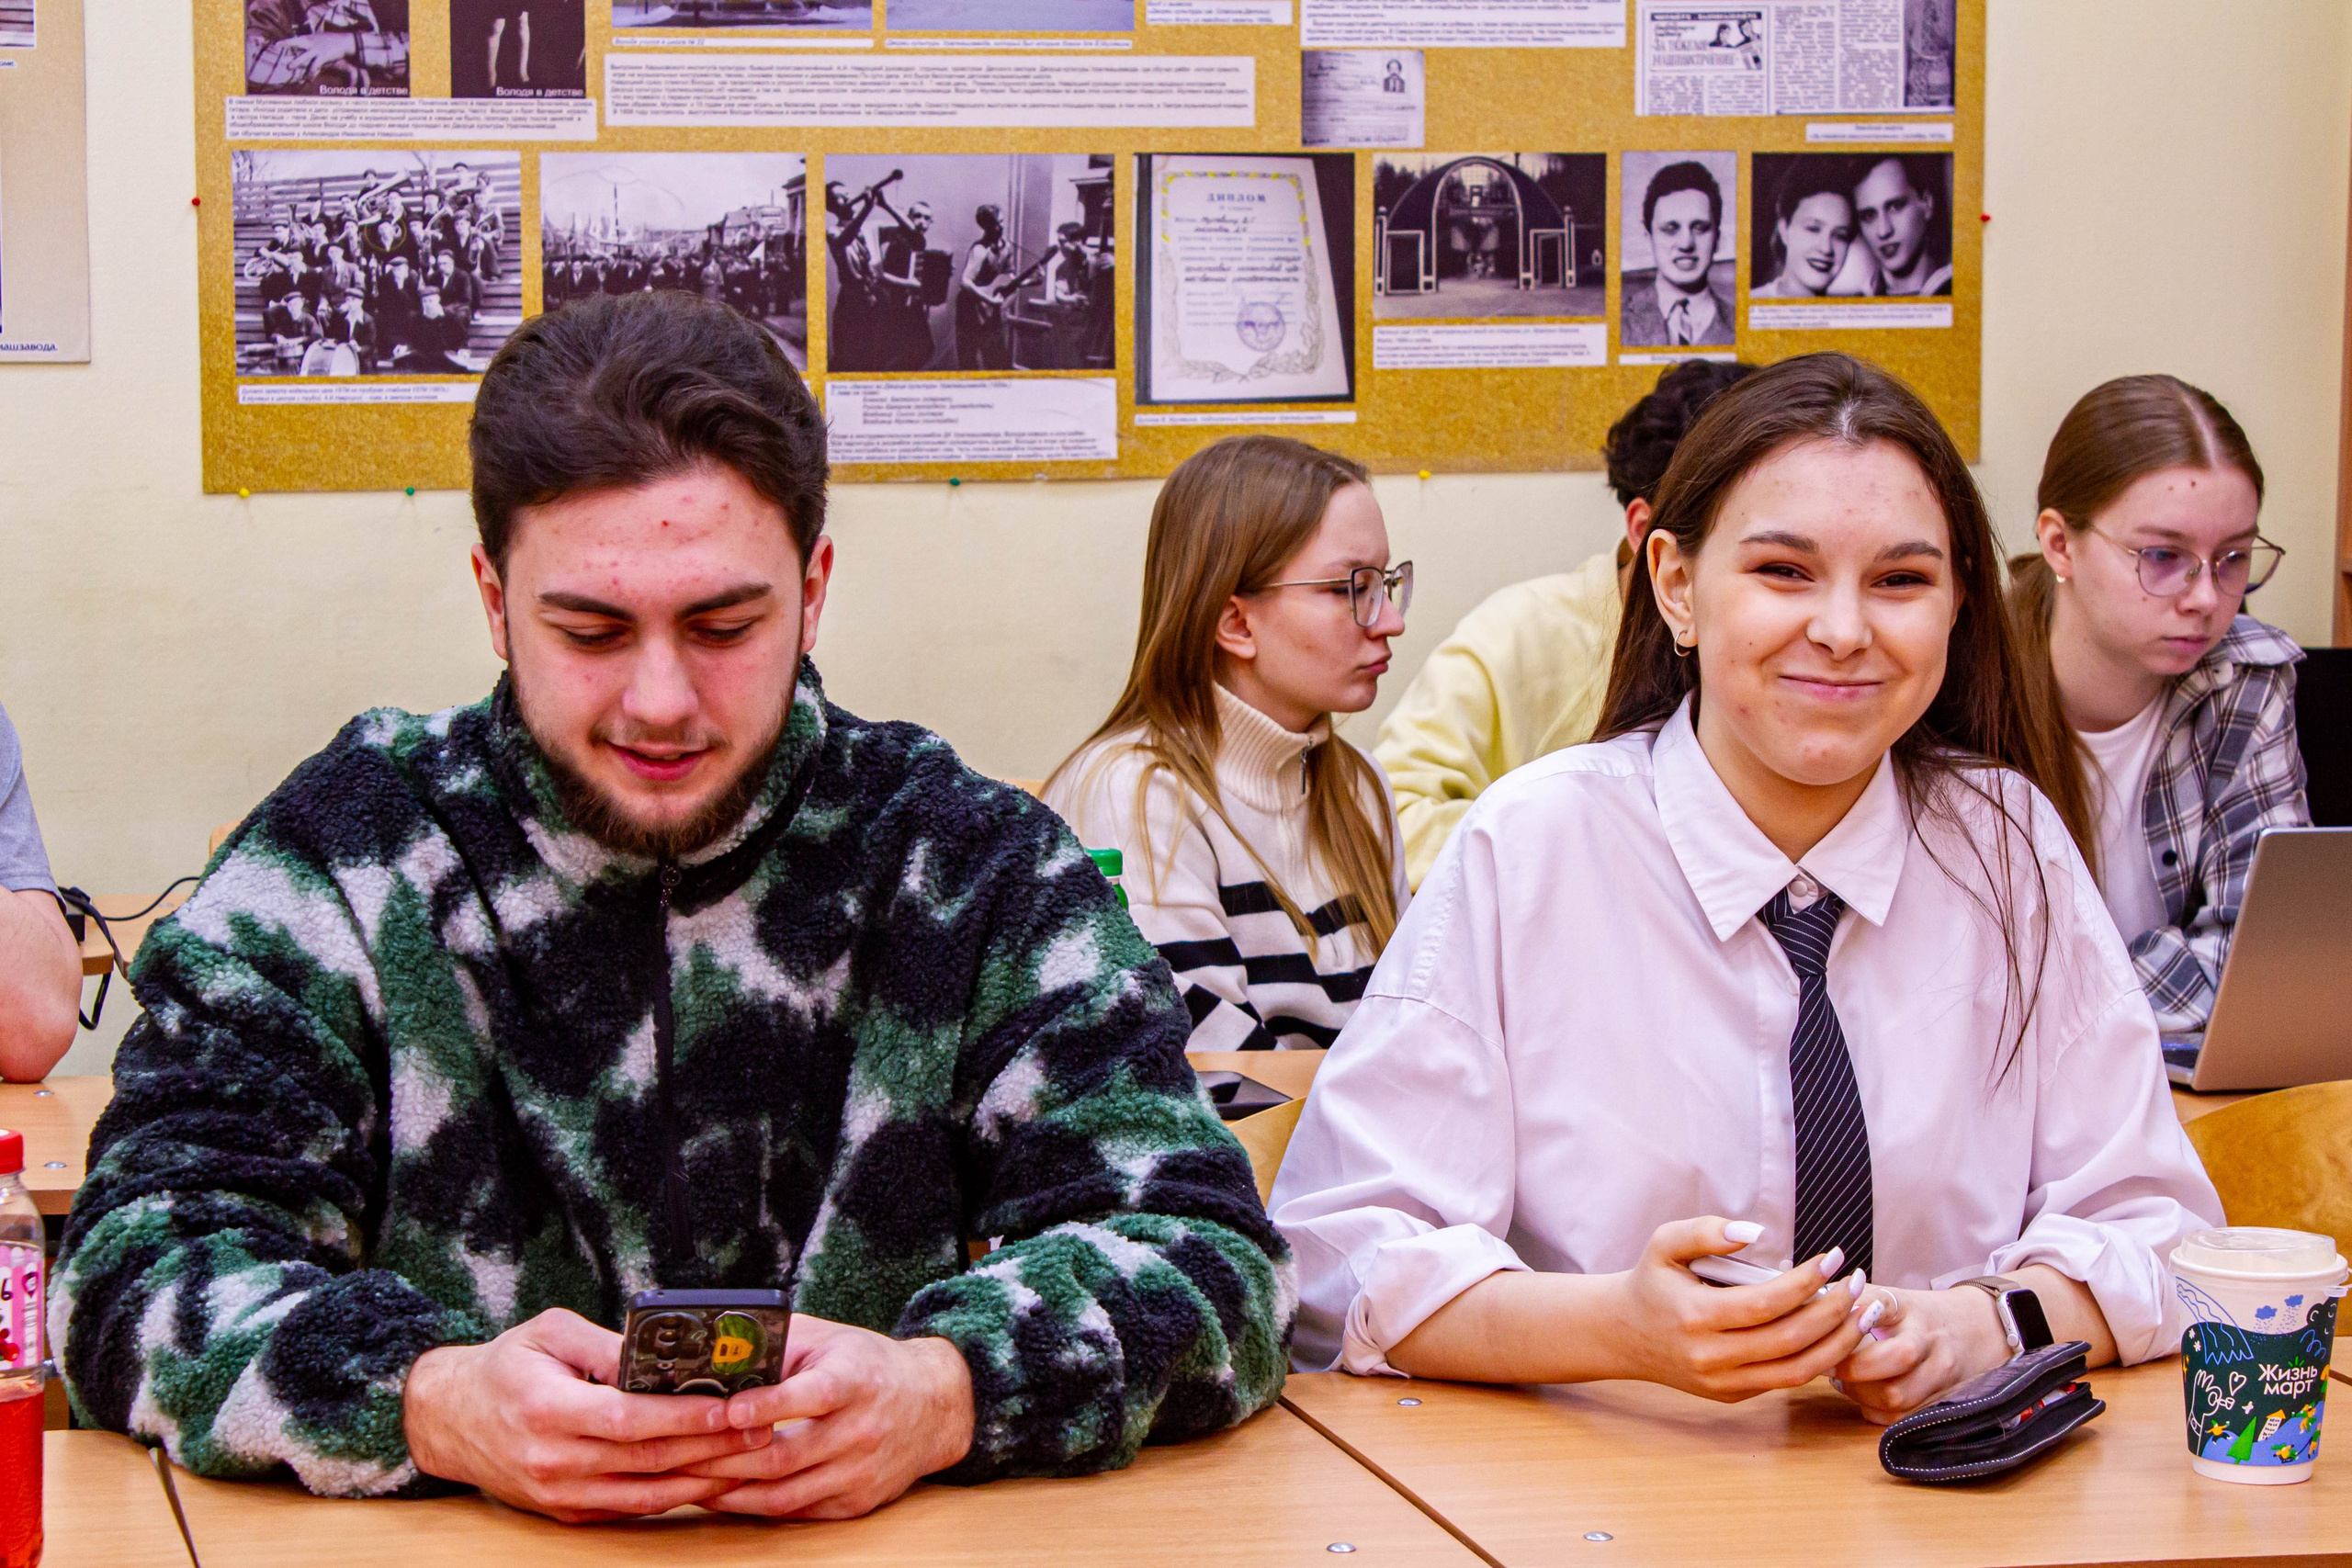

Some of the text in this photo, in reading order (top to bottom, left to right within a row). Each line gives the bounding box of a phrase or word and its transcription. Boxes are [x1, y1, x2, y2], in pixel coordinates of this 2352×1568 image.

[320, 85, 409, 96] Володя в детстве
[496, 86, 583, 97] Володя в детстве
[1207, 193, 1266, 202] ДИПЛОМ
[2258, 1363, 2318, 1382] Жизнь
[2264, 1379, 2314, 1399] март
